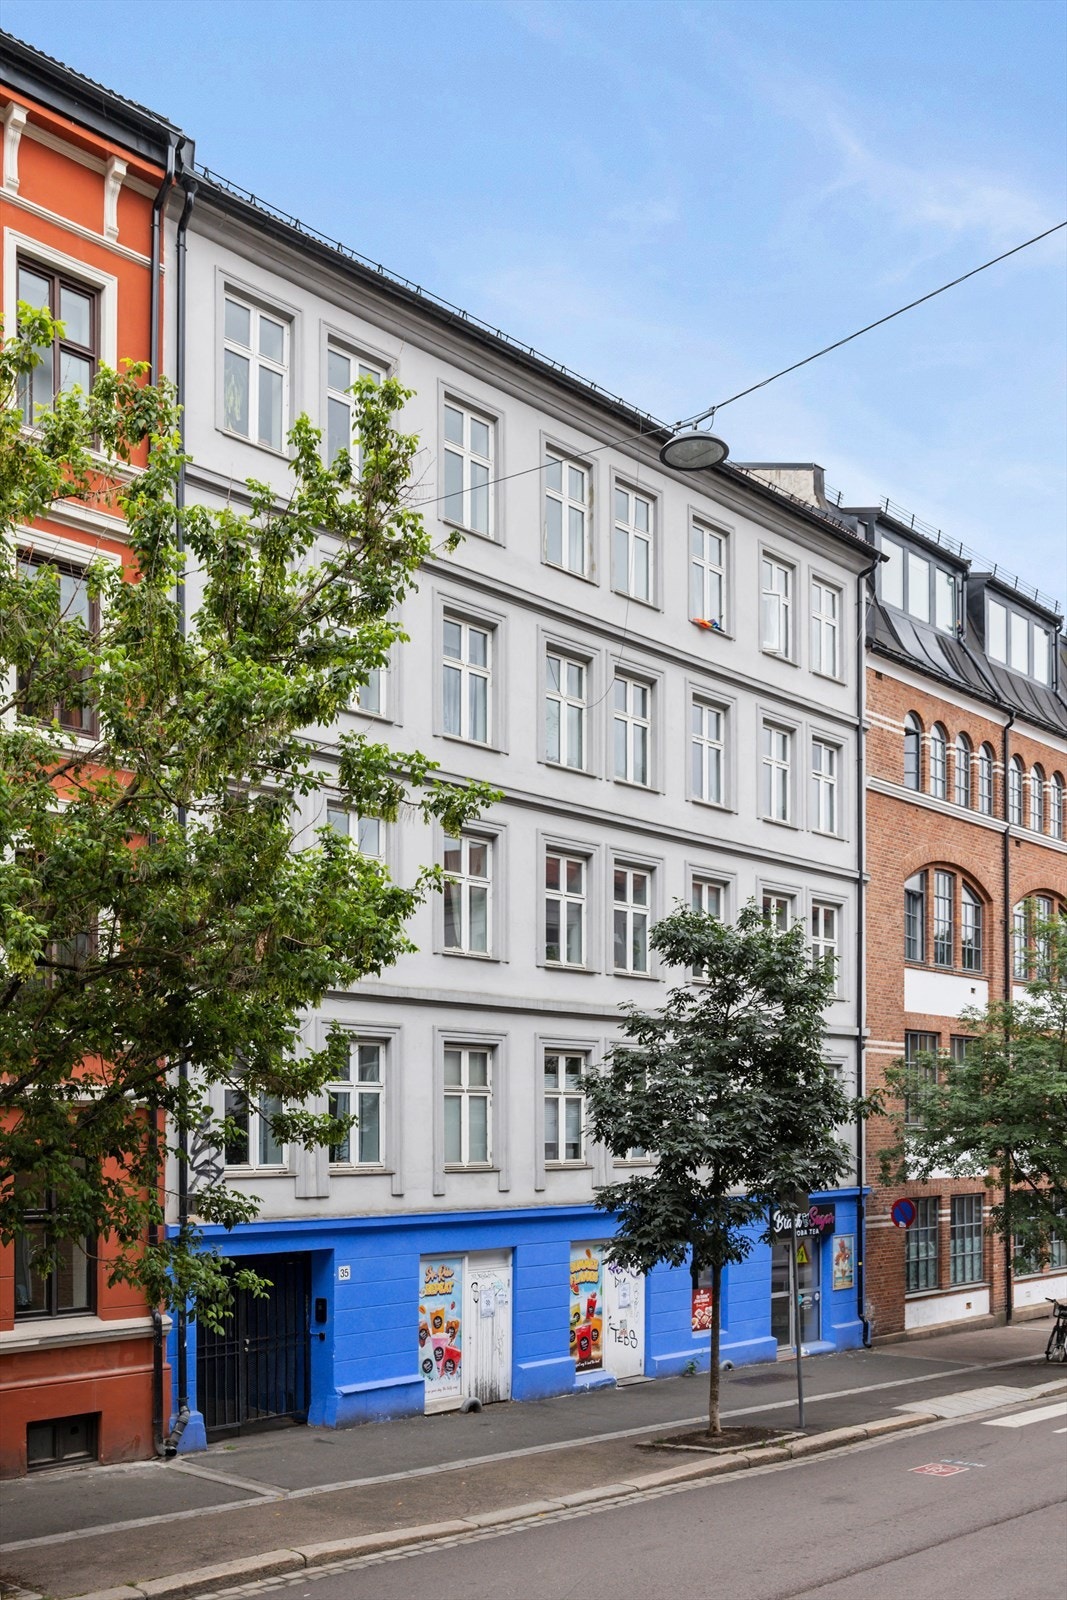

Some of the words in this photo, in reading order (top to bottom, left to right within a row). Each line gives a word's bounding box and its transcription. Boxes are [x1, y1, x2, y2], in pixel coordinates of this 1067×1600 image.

[809, 1206, 835, 1231] Sugar
[795, 1229, 808, 1237] OBA
[340, 1268, 349, 1278] 35
